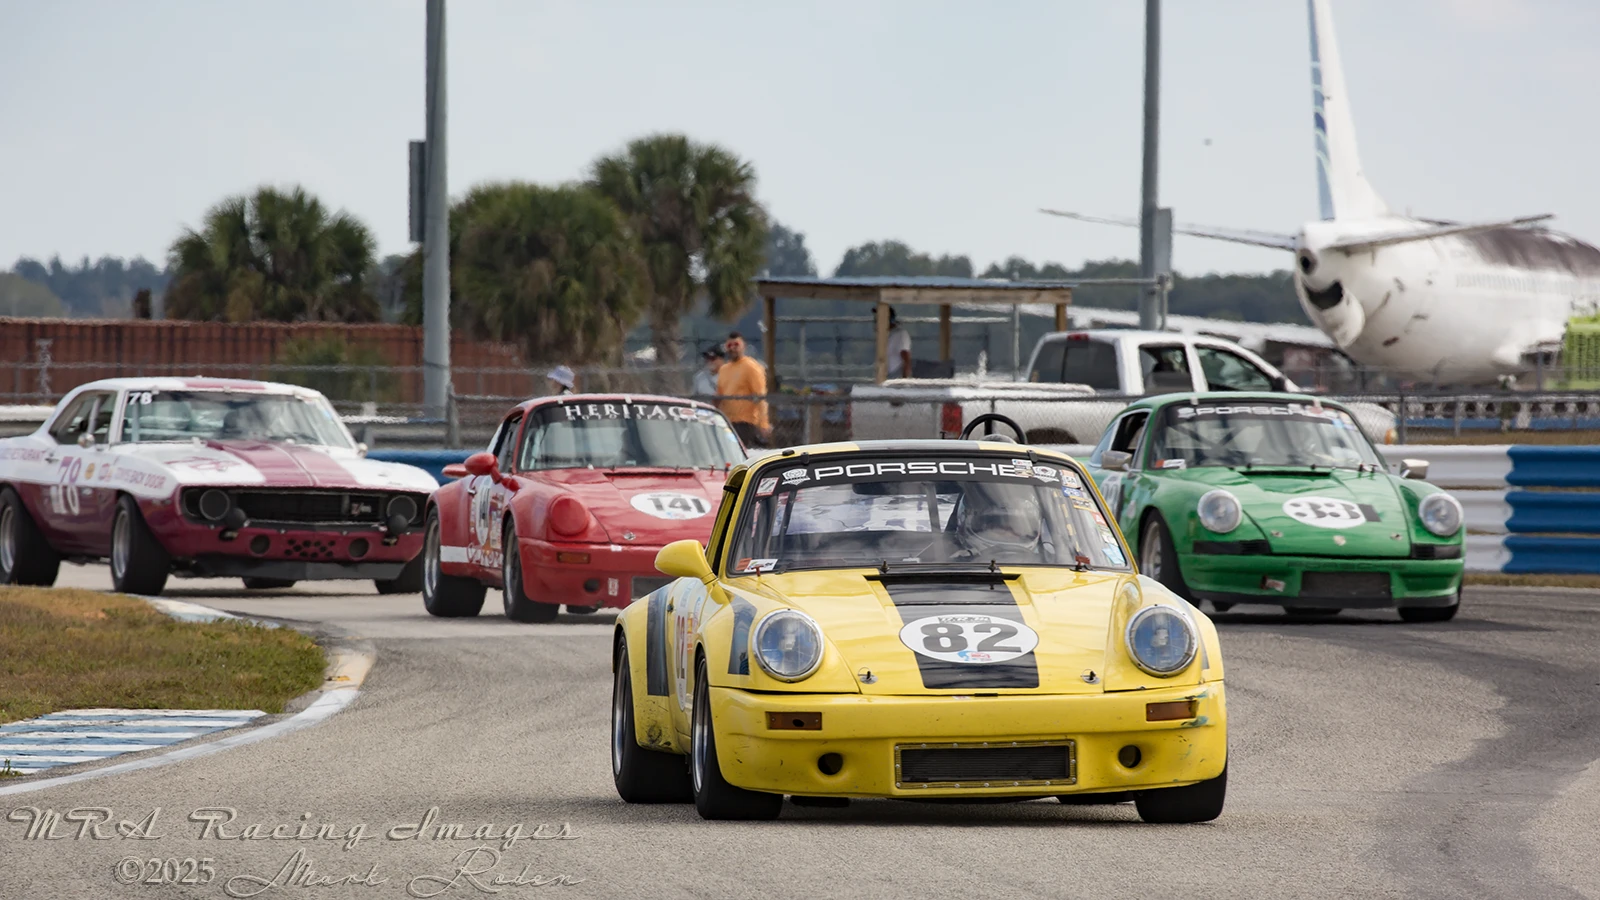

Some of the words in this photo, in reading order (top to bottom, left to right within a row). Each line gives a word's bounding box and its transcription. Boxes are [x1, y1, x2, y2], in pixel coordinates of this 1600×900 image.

[129, 392, 152, 405] 78
[814, 461, 1016, 481] PORSCHE
[647, 497, 706, 514] 141
[920, 623, 1022, 653] 82
